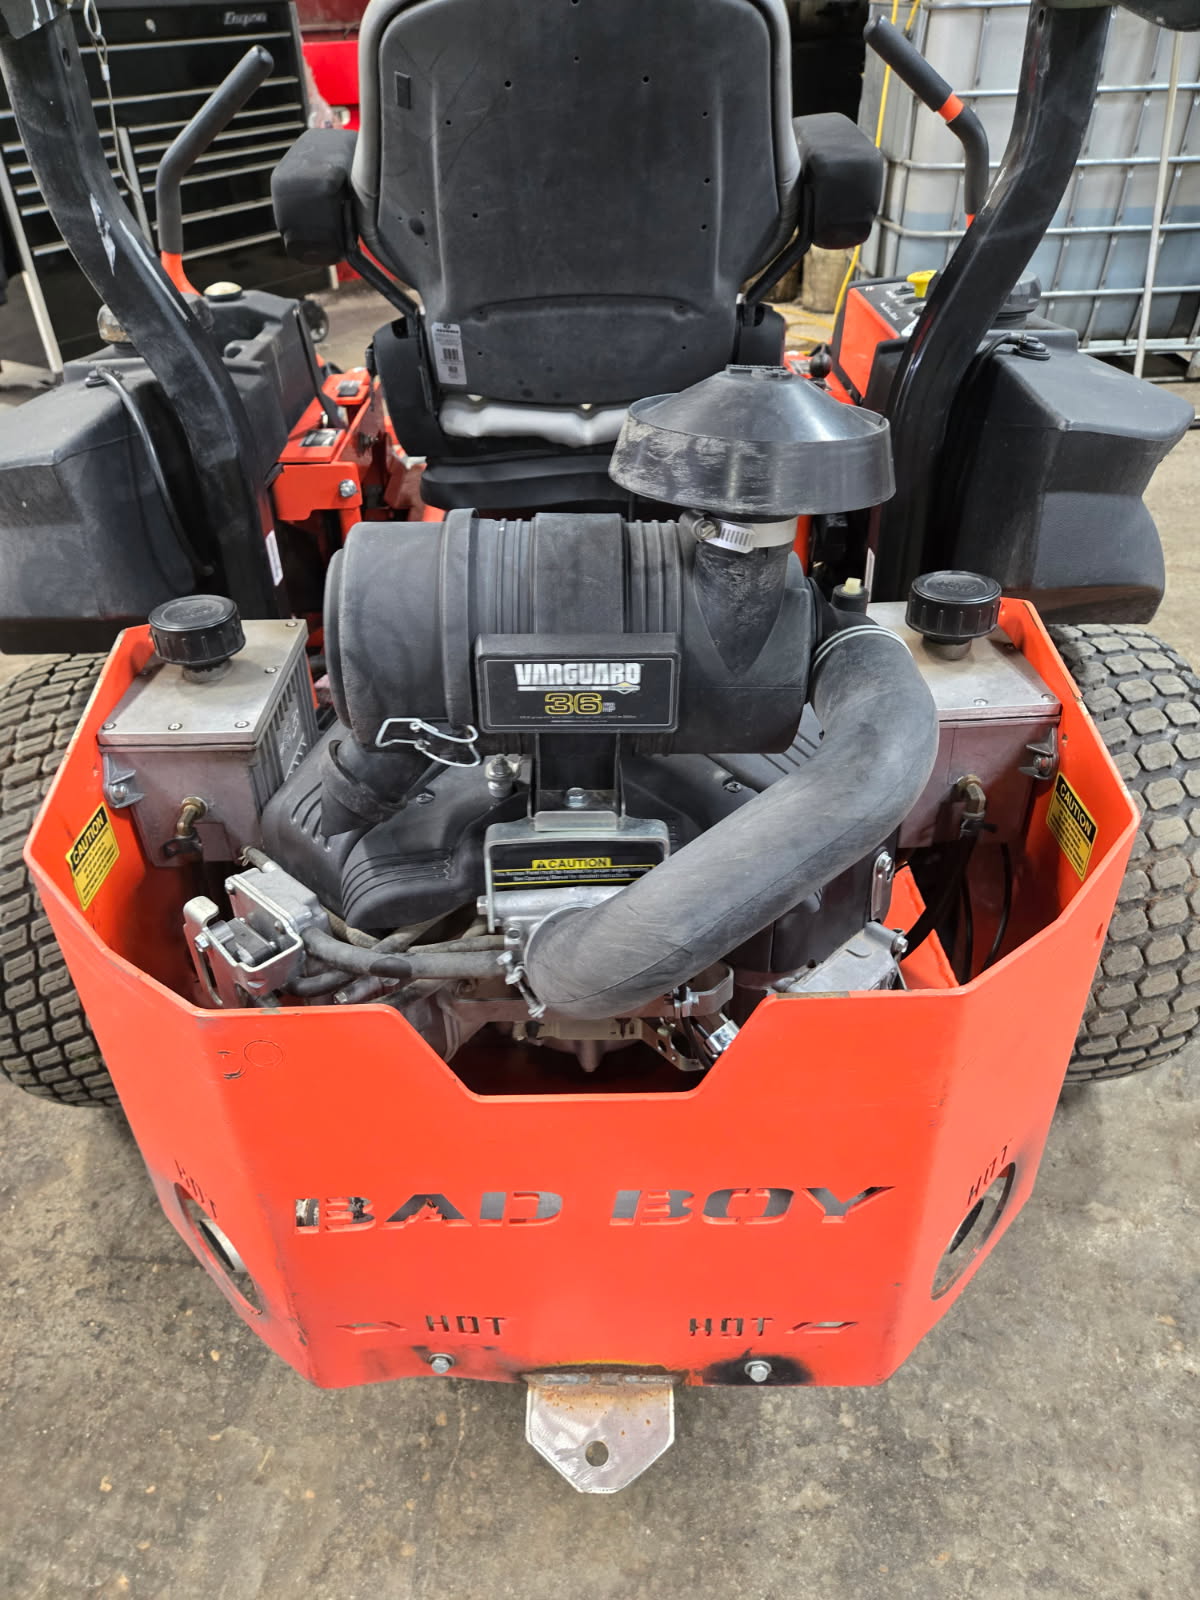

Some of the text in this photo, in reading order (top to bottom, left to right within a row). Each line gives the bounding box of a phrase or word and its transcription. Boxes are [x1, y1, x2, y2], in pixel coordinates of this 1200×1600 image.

[514, 663, 641, 685] VANGUARD
[544, 693, 603, 715] 36
[1060, 783, 1093, 837] CAUTION
[72, 812, 105, 865] CAUTION
[549, 858, 608, 869] CAUTION
[294, 1185, 897, 1234] BAD BOY
[425, 1315, 506, 1336] HOT
[689, 1317, 774, 1337] HOT
